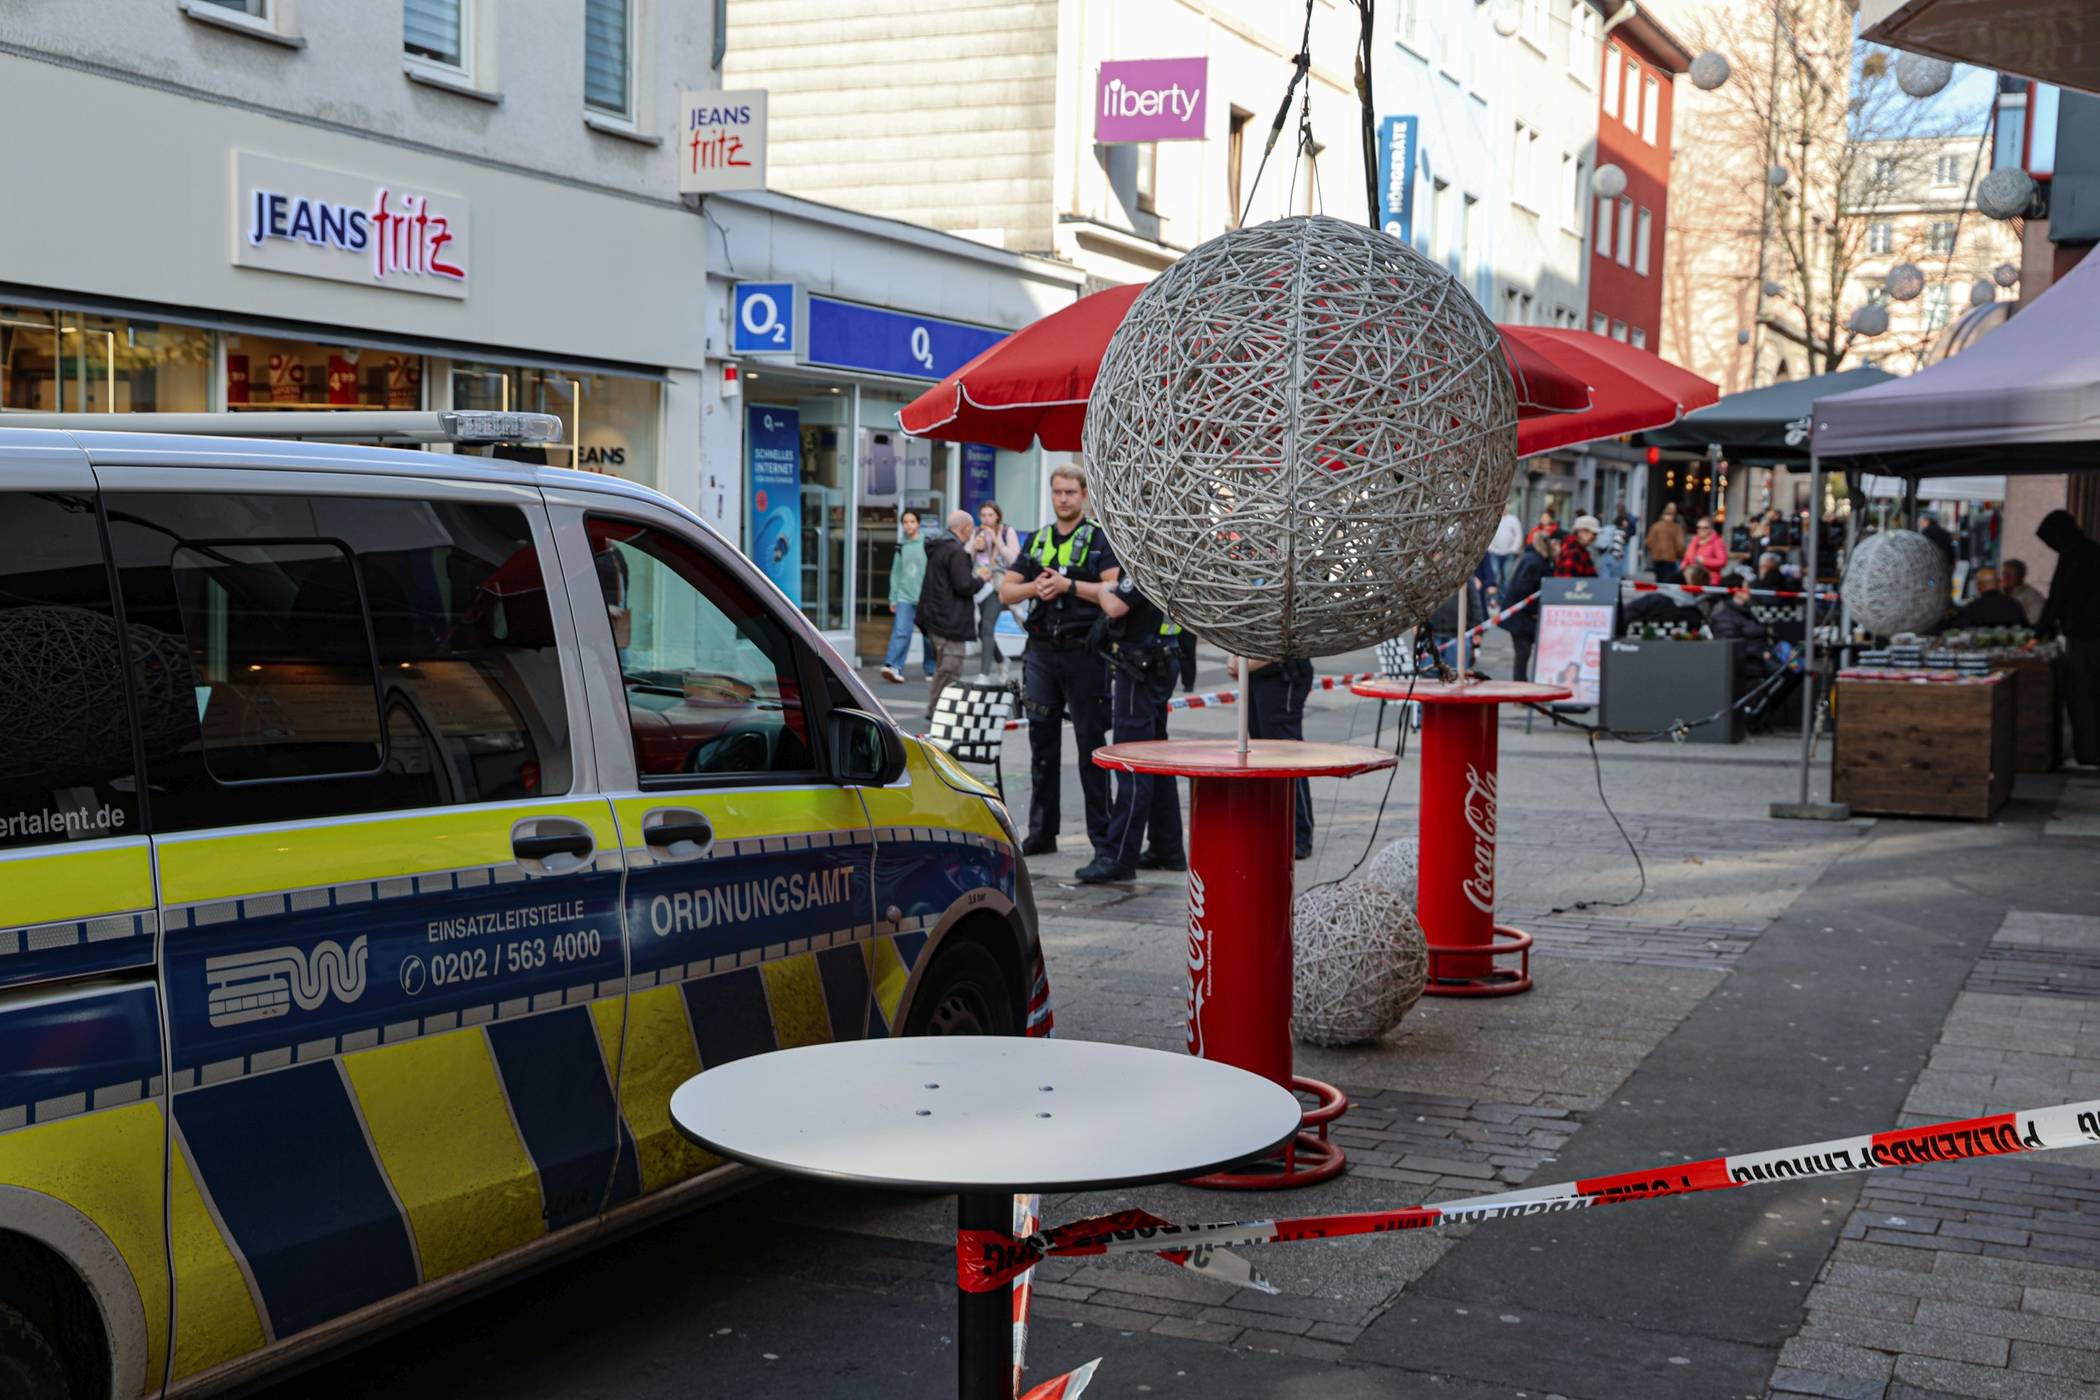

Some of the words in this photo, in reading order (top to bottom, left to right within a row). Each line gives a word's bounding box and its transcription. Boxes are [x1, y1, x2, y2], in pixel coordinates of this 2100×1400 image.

[690, 106, 751, 131] JEANS
[1103, 78, 1200, 122] liberty
[690, 129, 752, 175] fritz
[1386, 121, 1408, 214] HÖRGERÄTE
[255, 191, 368, 249] JEANS
[373, 191, 464, 276] fritz
[754, 448, 794, 460] SCHNELLES
[754, 462, 794, 475] INTERNET
[0, 803, 125, 837] ertalent.de
[427, 900, 585, 943] EINSATZLEITSTELLE
[651, 866, 854, 937] ORDNUNGSAMT
[431, 948, 488, 986] 0202
[493, 944, 502, 976] /
[507, 938, 545, 972] 563
[552, 929, 600, 963] 4000
